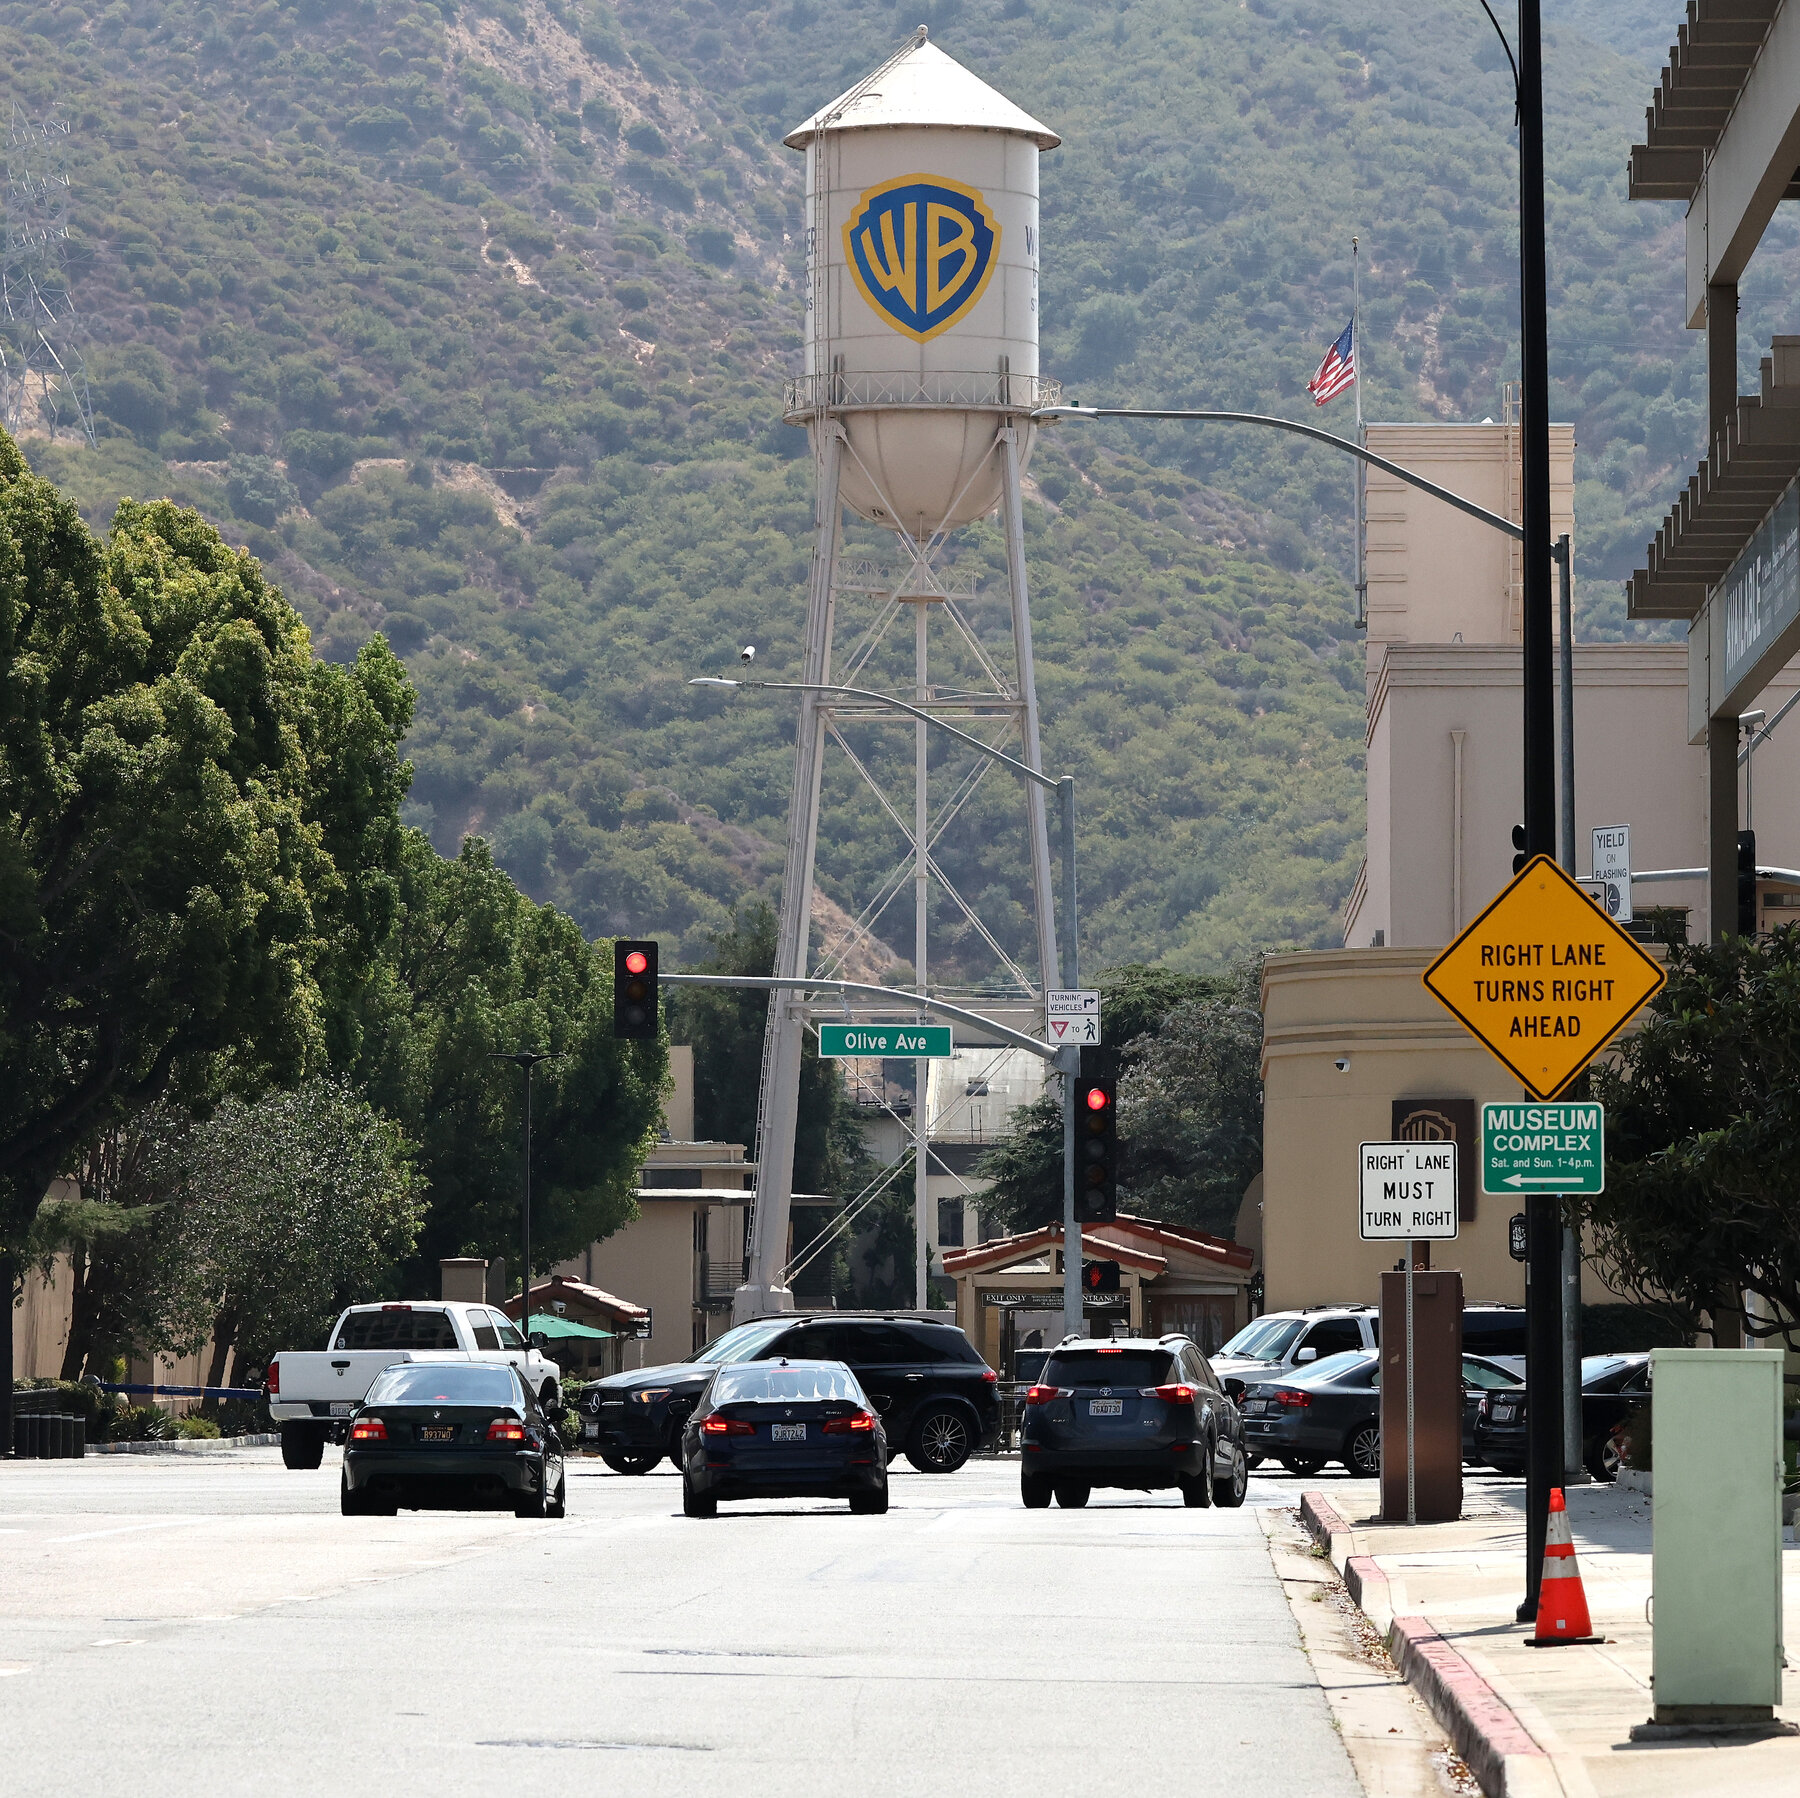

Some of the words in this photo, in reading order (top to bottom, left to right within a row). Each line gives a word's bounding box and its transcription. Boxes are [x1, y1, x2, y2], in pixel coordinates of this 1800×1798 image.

[861, 202, 977, 315] WB
[1597, 832, 1625, 848] YIELD
[1606, 854, 1616, 863] ON
[1596, 868, 1627, 880] FLASHING
[1481, 945, 1544, 966] RIGHT
[1552, 944, 1606, 966] LANE
[1051, 994, 1082, 1002] TURNING
[1474, 980, 1544, 1002] TURNS
[1553, 979, 1614, 1001] RIGHT
[1509, 1016, 1580, 1037] AHEAD
[845, 1033, 887, 1050] Olive
[895, 1034, 926, 1050] Ave
[1488, 1109, 1597, 1131] MUSEUM
[1493, 1135, 1591, 1151] COMPLEX
[1367, 1156, 1404, 1170] RIGHT
[1416, 1155, 1450, 1169] LANE
[1491, 1157, 1510, 1168] Sat.
[1513, 1157, 1530, 1168] and
[1533, 1157, 1554, 1168] Sun.
[1384, 1182, 1434, 1199] MUST
[1366, 1212, 1401, 1226] TURN
[1413, 1211, 1451, 1226] RIGHT
